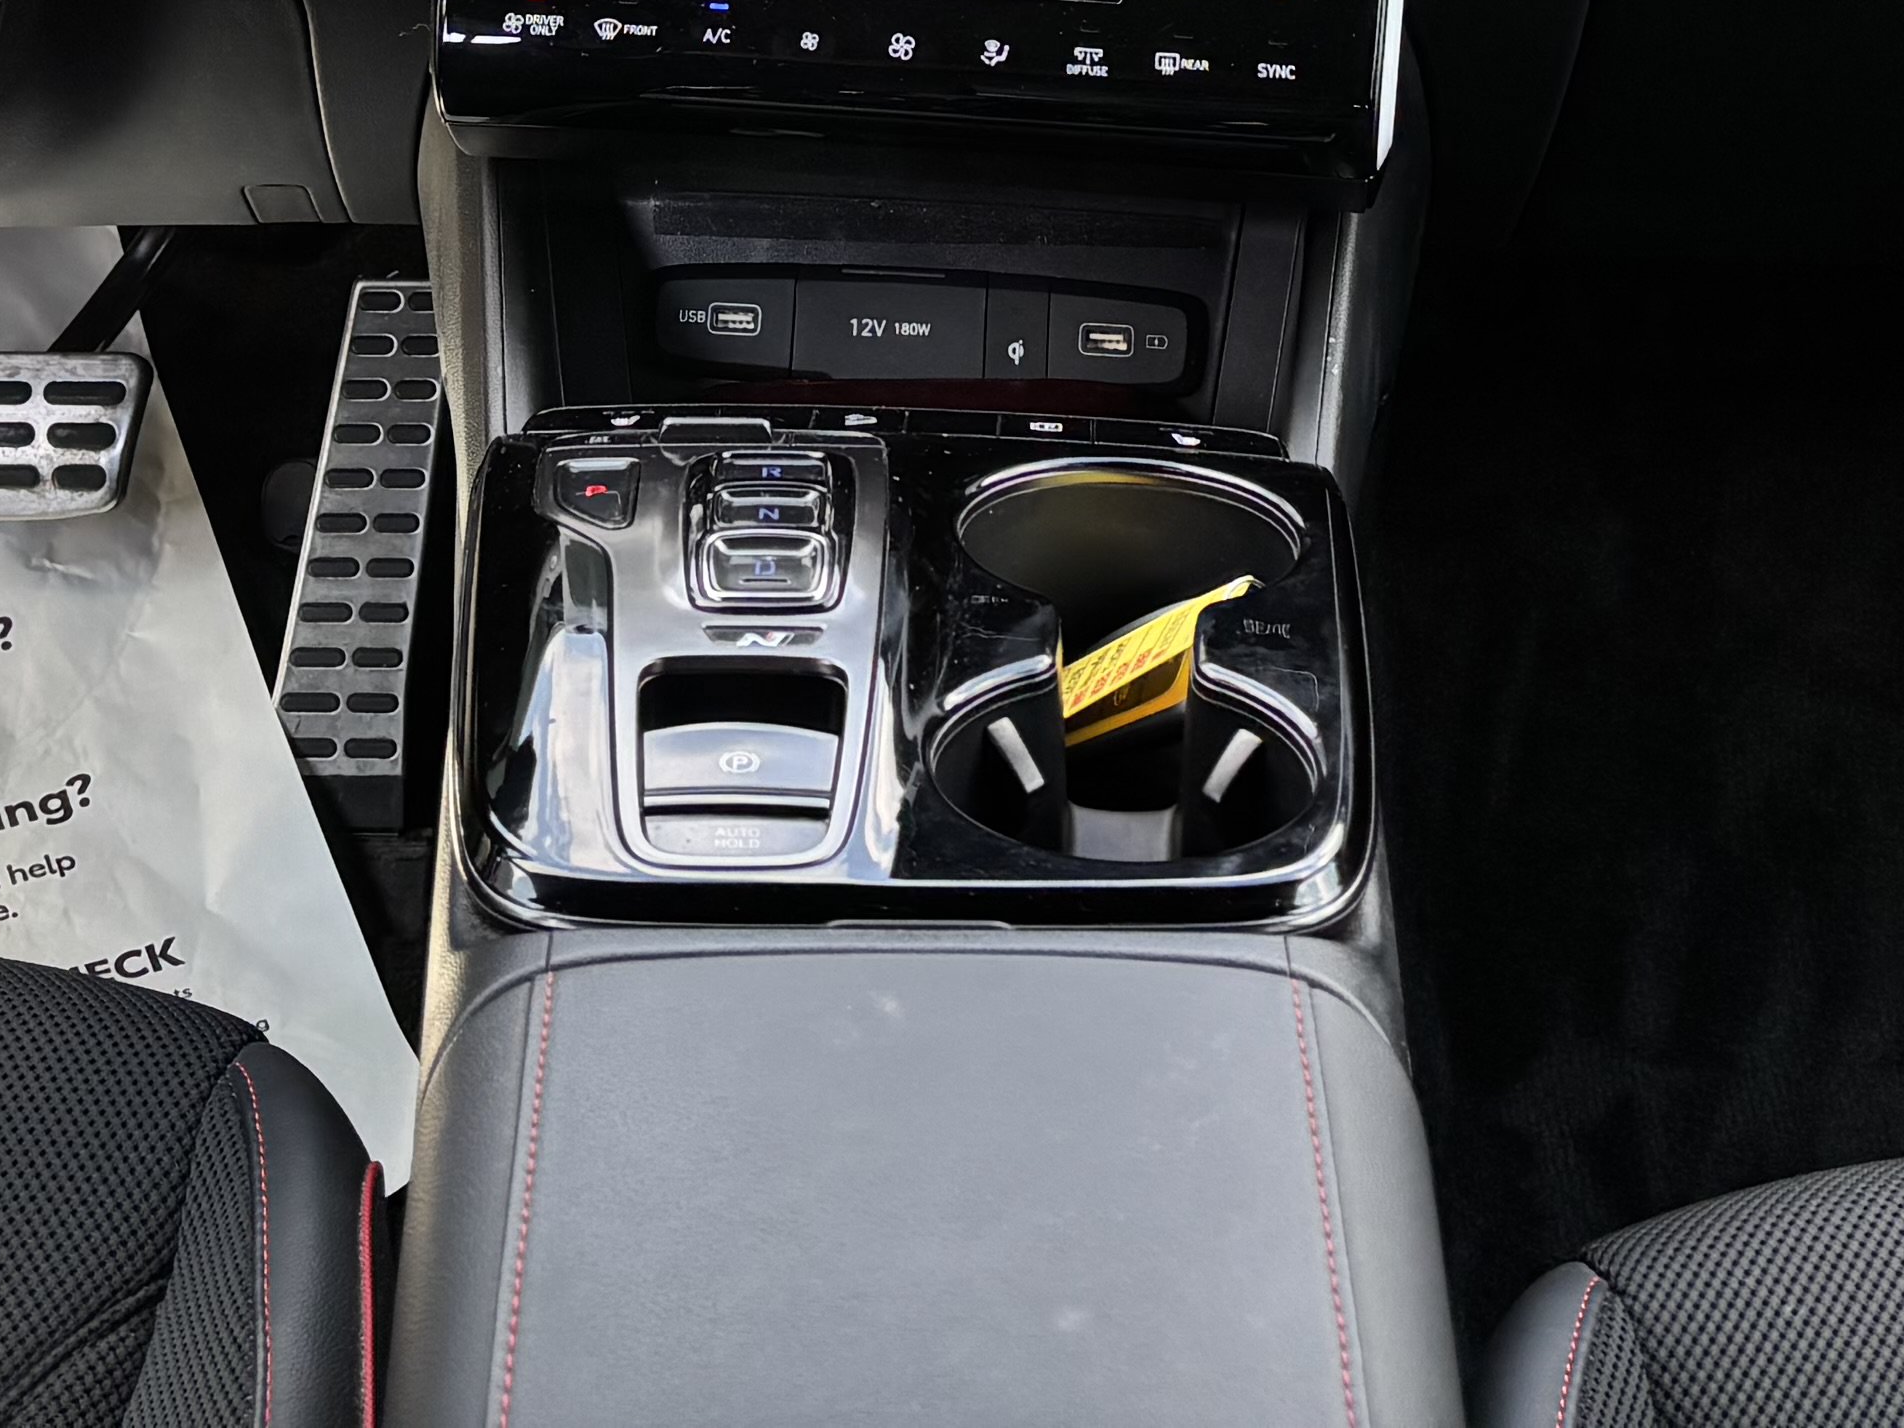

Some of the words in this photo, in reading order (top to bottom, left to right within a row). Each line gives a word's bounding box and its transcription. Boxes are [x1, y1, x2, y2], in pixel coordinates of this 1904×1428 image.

[525, 14, 564, 28] DRIVER
[529, 23, 559, 37] ONLY
[623, 24, 658, 38] FRONT
[702, 27, 732, 44] A/C
[1066, 63, 1109, 78] DIFFUSE
[1180, 58, 1210, 73] REAR
[1257, 62, 1297, 80] SYNC
[678, 309, 707, 324] USB
[849, 318, 887, 338] 12V
[894, 321, 932, 337] 180W
[761, 466, 783, 479] R
[758, 507, 780, 521] N
[753, 559, 777, 576] D
[714, 827, 762, 838] AUTO
[714, 838, 761, 849] HOLD
[7, 849, 78, 889] help
[69, 936, 186, 978] ECK
